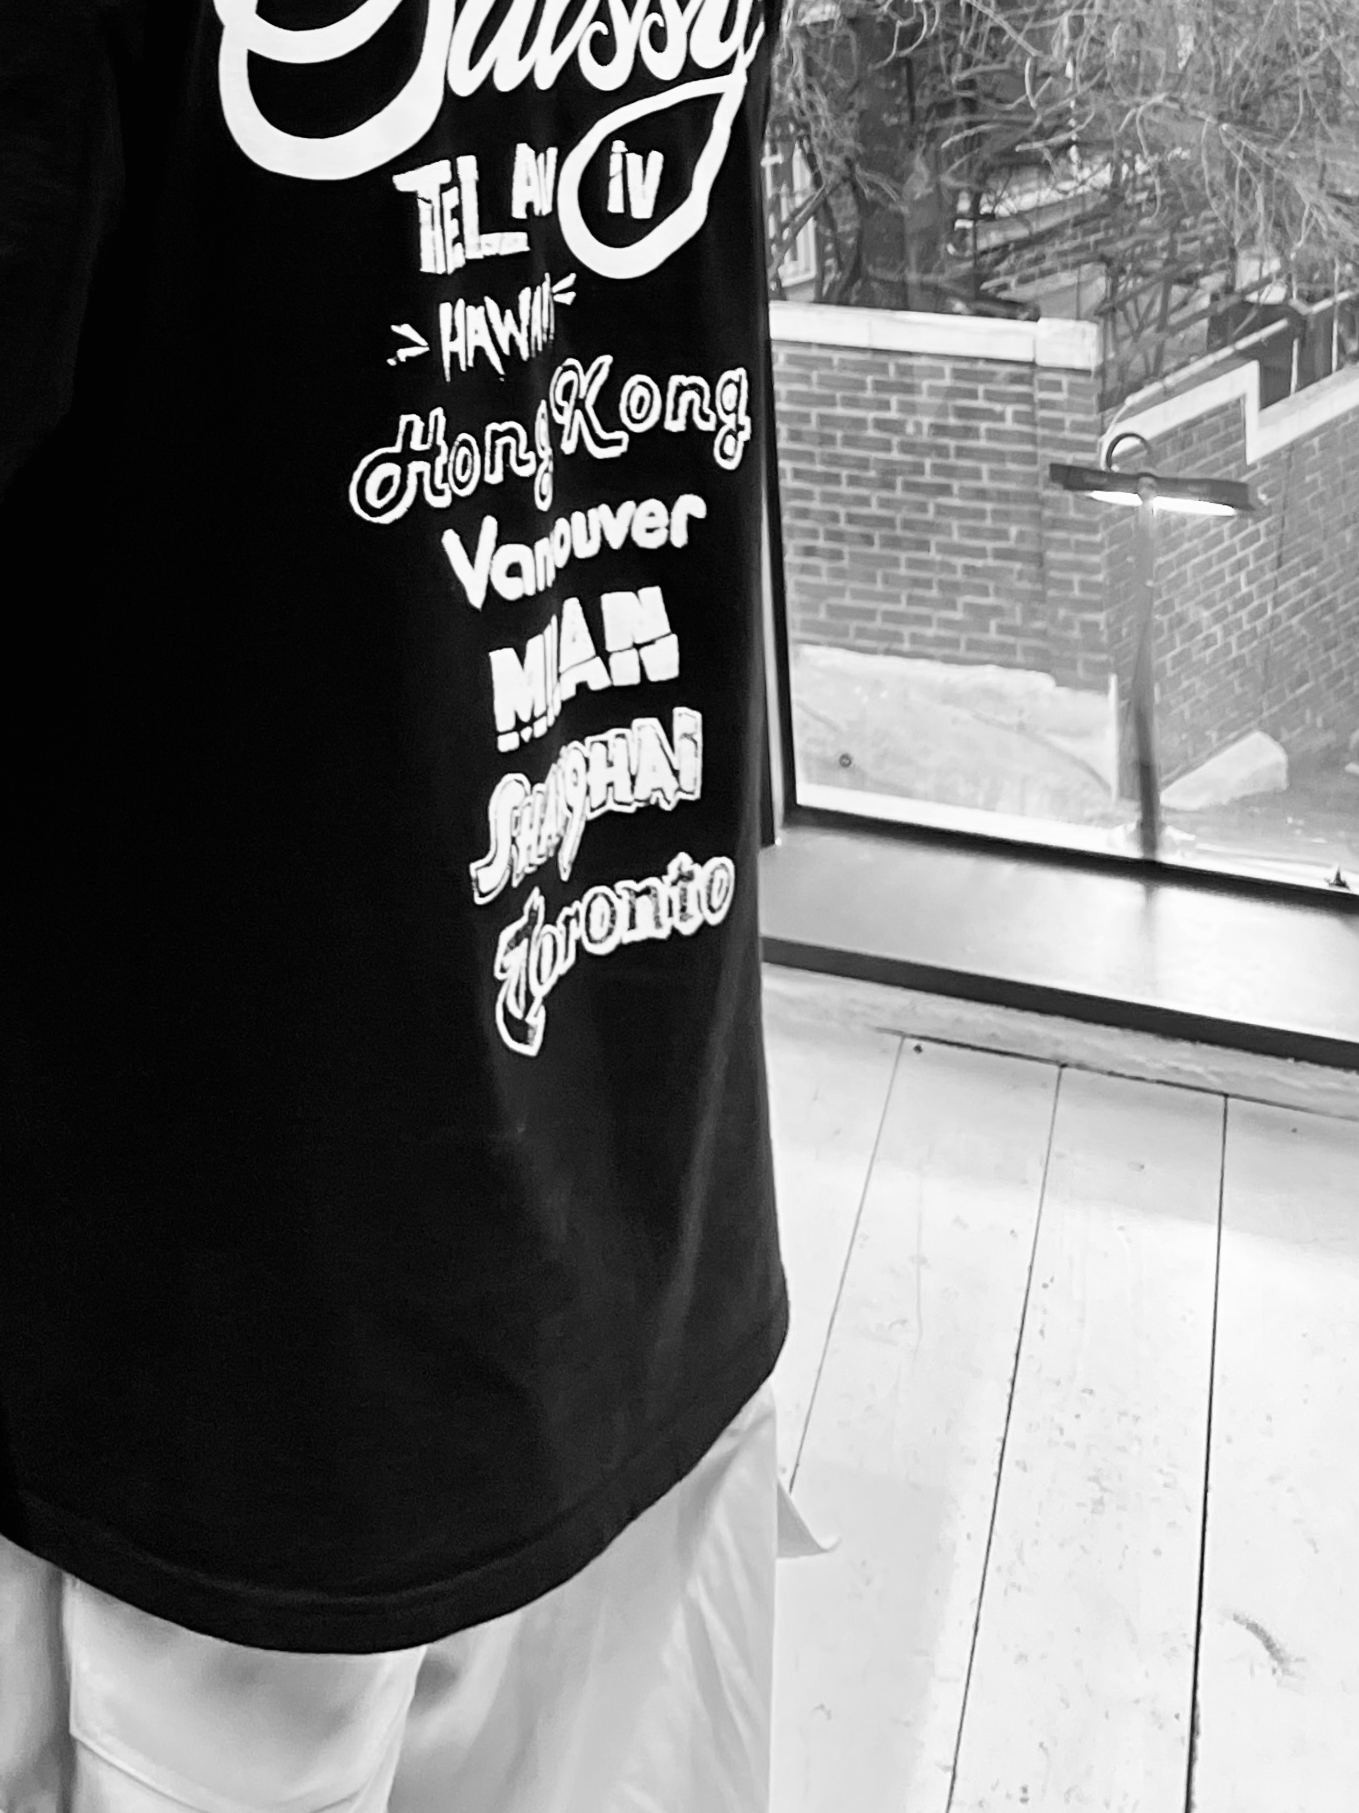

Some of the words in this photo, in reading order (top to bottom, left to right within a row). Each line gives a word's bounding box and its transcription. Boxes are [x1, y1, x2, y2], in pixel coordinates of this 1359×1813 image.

[392, 154, 530, 275] TEL
[349, 399, 554, 525] Hong
[549, 354, 751, 470] Kong
[494, 851, 736, 1058] Toronto
